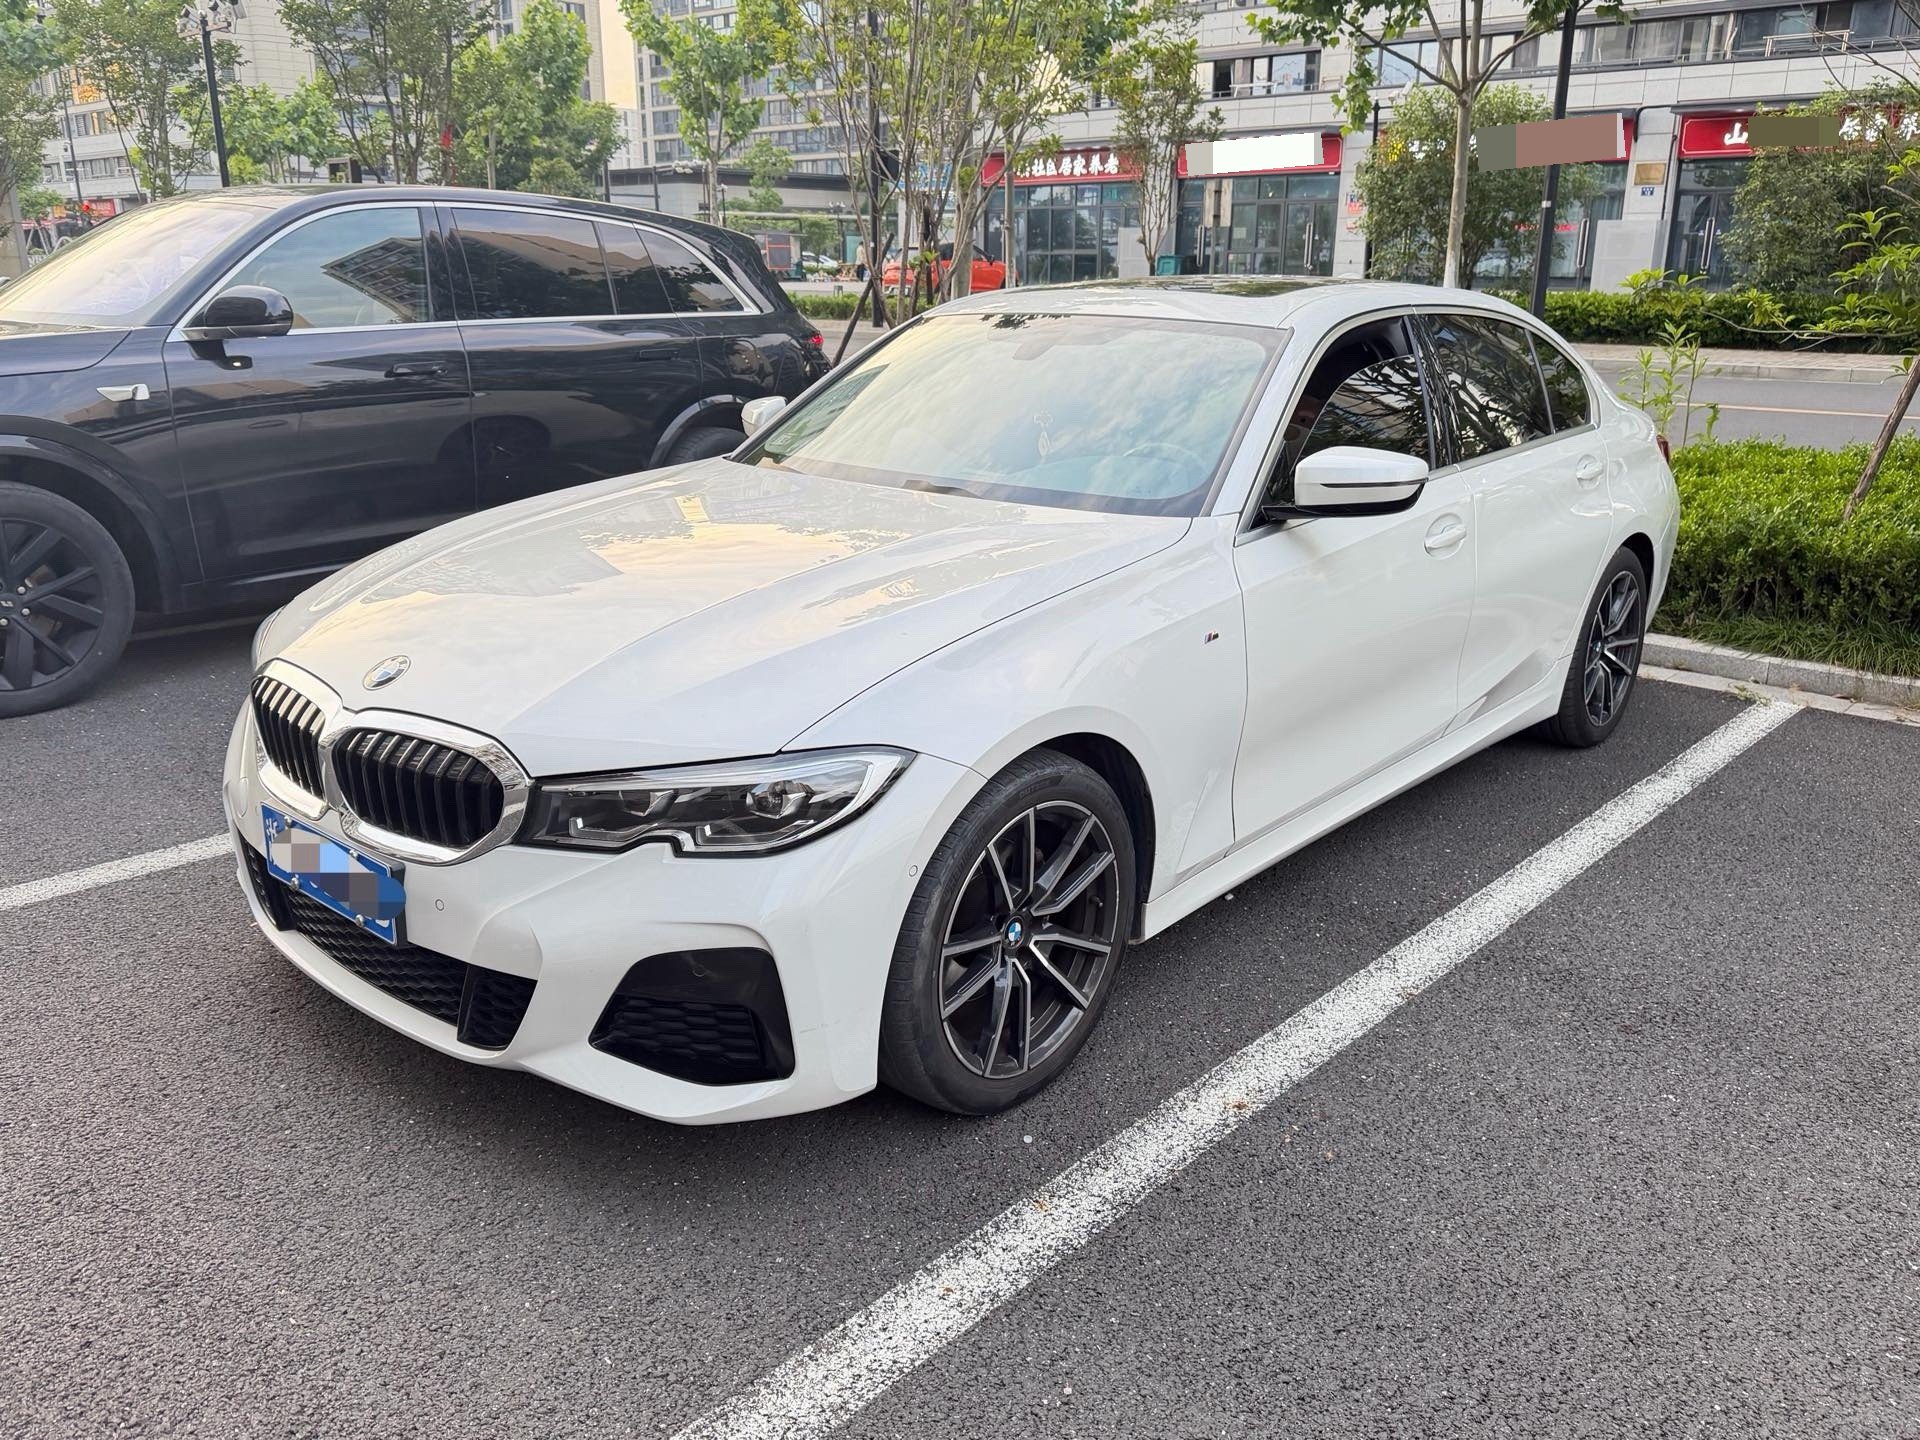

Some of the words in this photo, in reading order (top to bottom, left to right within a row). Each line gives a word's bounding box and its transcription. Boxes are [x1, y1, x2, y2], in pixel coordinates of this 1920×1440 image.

[1014, 152, 1120, 178] 社区居家养老
